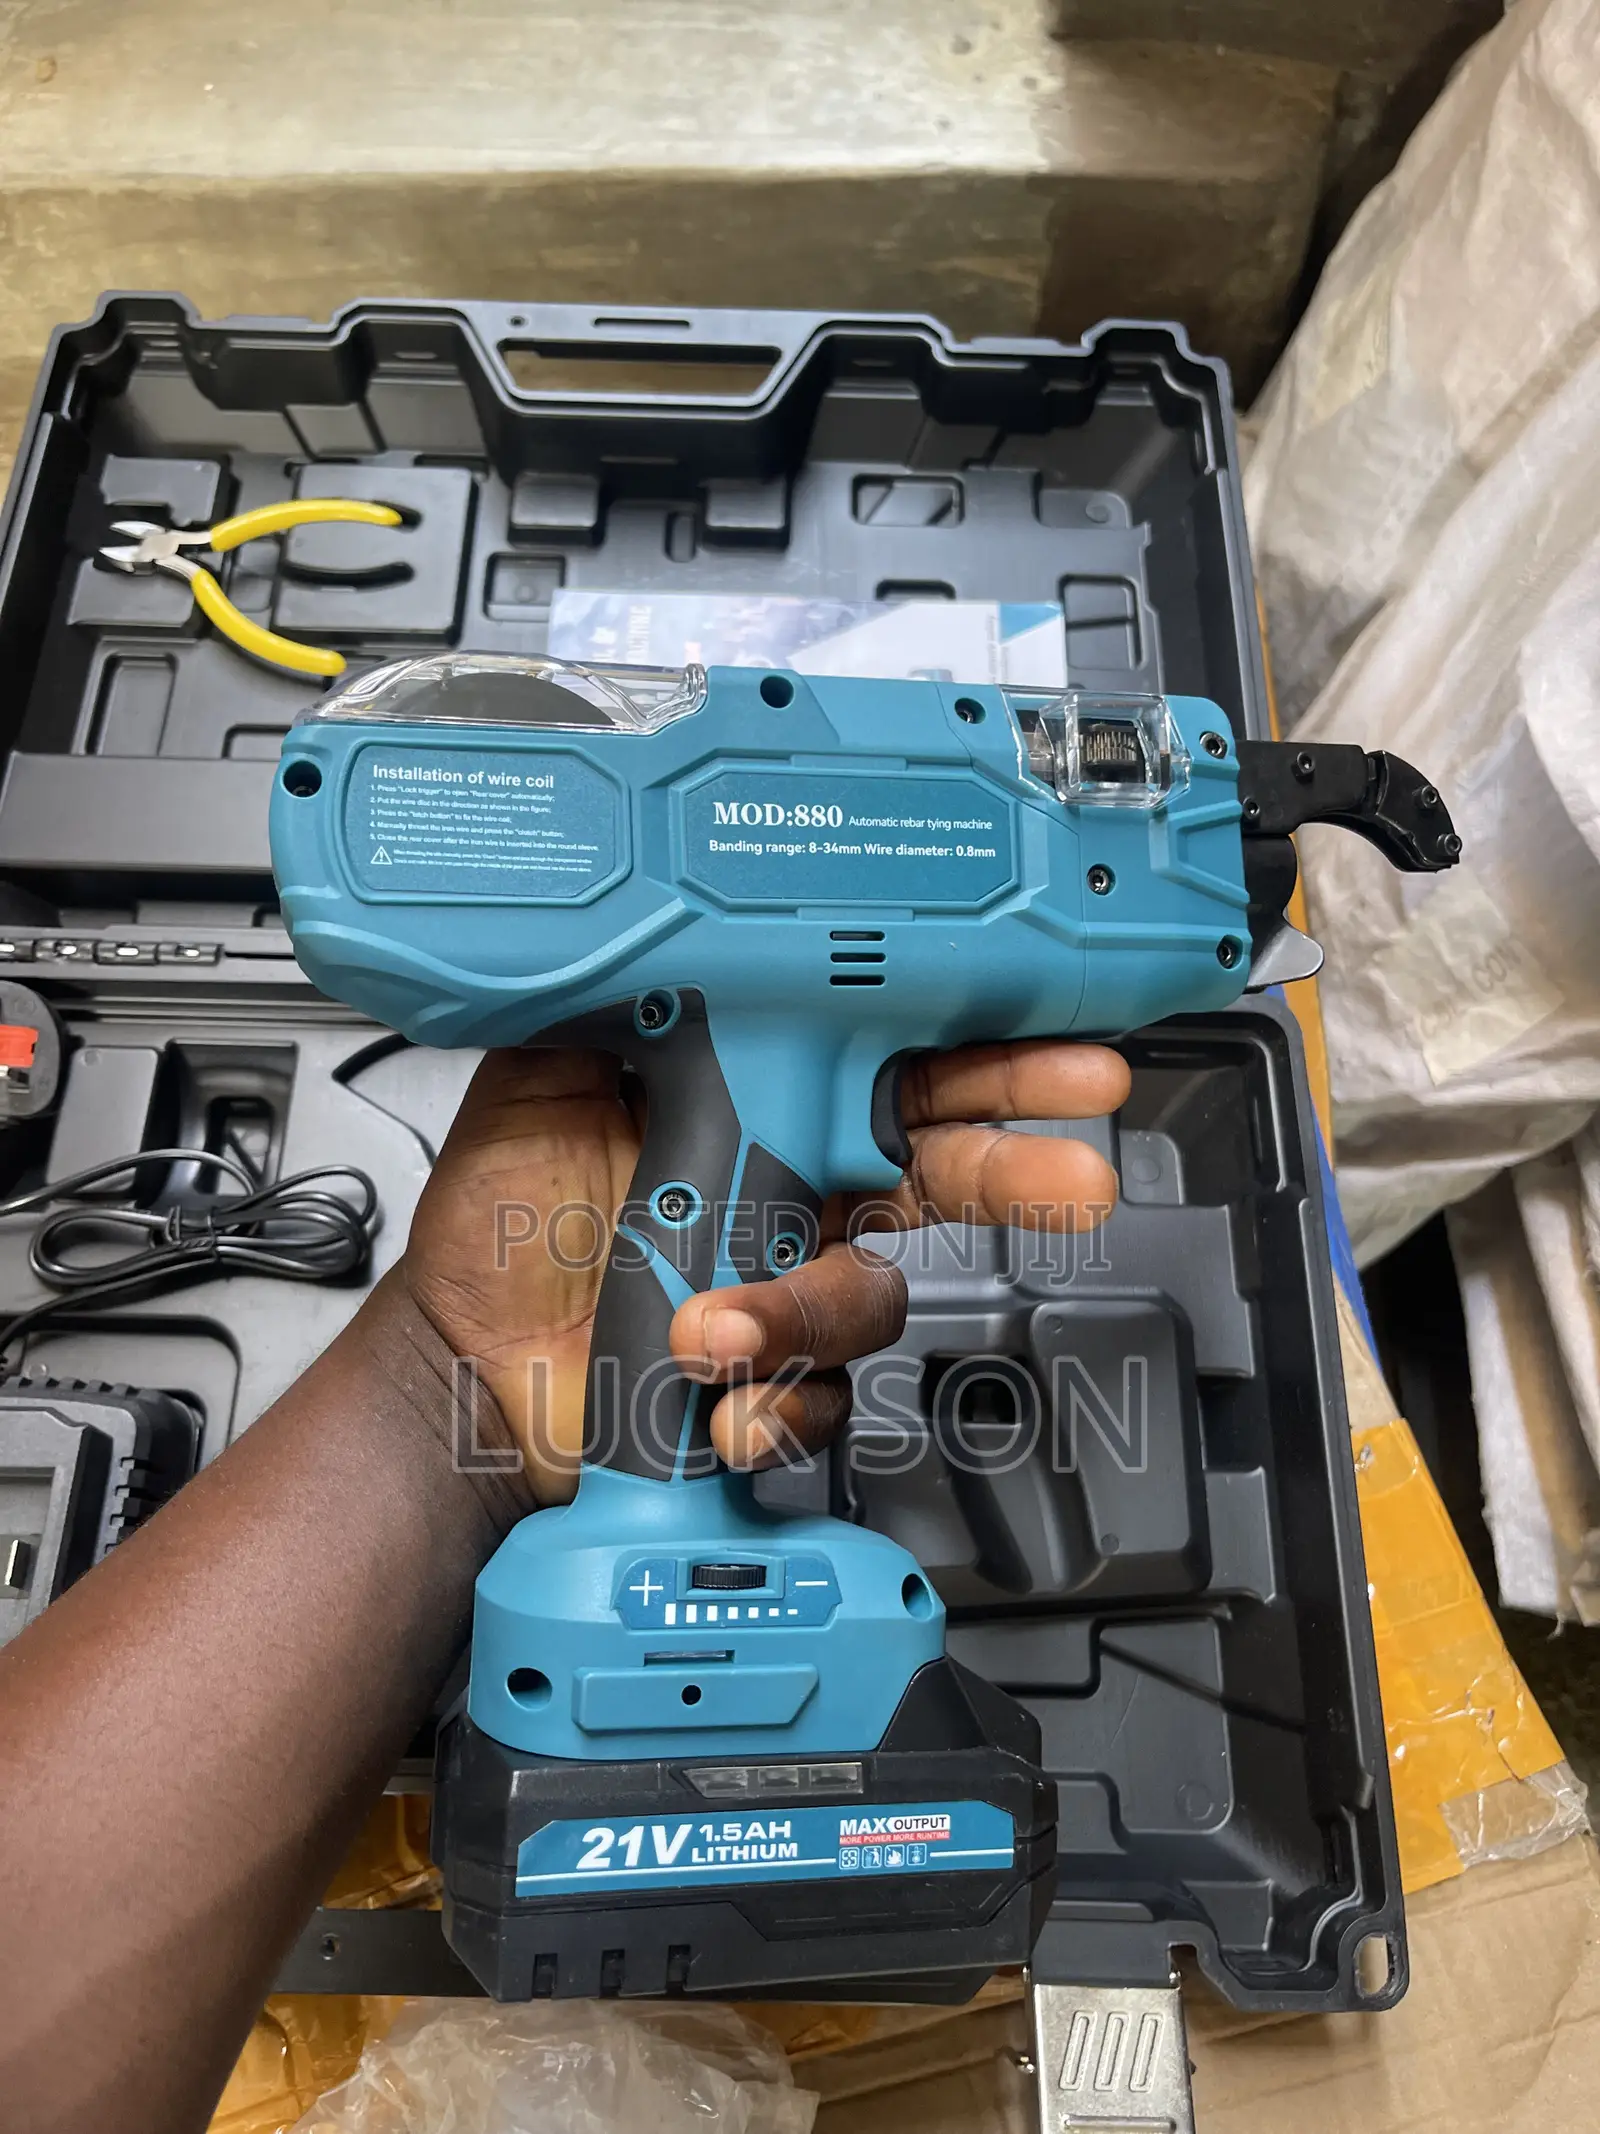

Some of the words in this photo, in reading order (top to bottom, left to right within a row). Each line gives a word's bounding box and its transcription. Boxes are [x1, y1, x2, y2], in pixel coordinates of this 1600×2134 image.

[373, 764, 462, 783] Installation
[468, 770, 484, 785] of
[488, 772, 522, 787] wire
[525, 775, 554, 789] coil
[451, 801, 479, 809] direction
[712, 801, 844, 829] MOD:880
[848, 815, 899, 828] Automatic
[900, 816, 925, 828] rebar
[927, 818, 952, 832] tying
[953, 818, 992, 830] machine
[709, 840, 763, 856] Banding
[766, 843, 806, 856] range:
[808, 842, 862, 855] 8-34mm
[864, 843, 893, 856] Wire
[896, 843, 953, 857] diameter:
[956, 846, 996, 858] 0.8mm
[840, 1817, 887, 1836] MAX
[894, 1817, 947, 1830] OUTPUT
[576, 1823, 693, 1870] 21V
[698, 1820, 791, 1842] 1.5AH
[840, 1836, 862, 1844] MORE
[863, 1834, 892, 1843] POWER
[893, 1833, 914, 1842] MORE
[916, 1831, 950, 1840] RUNTIME
[691, 1842, 799, 1864] LITHIUM
